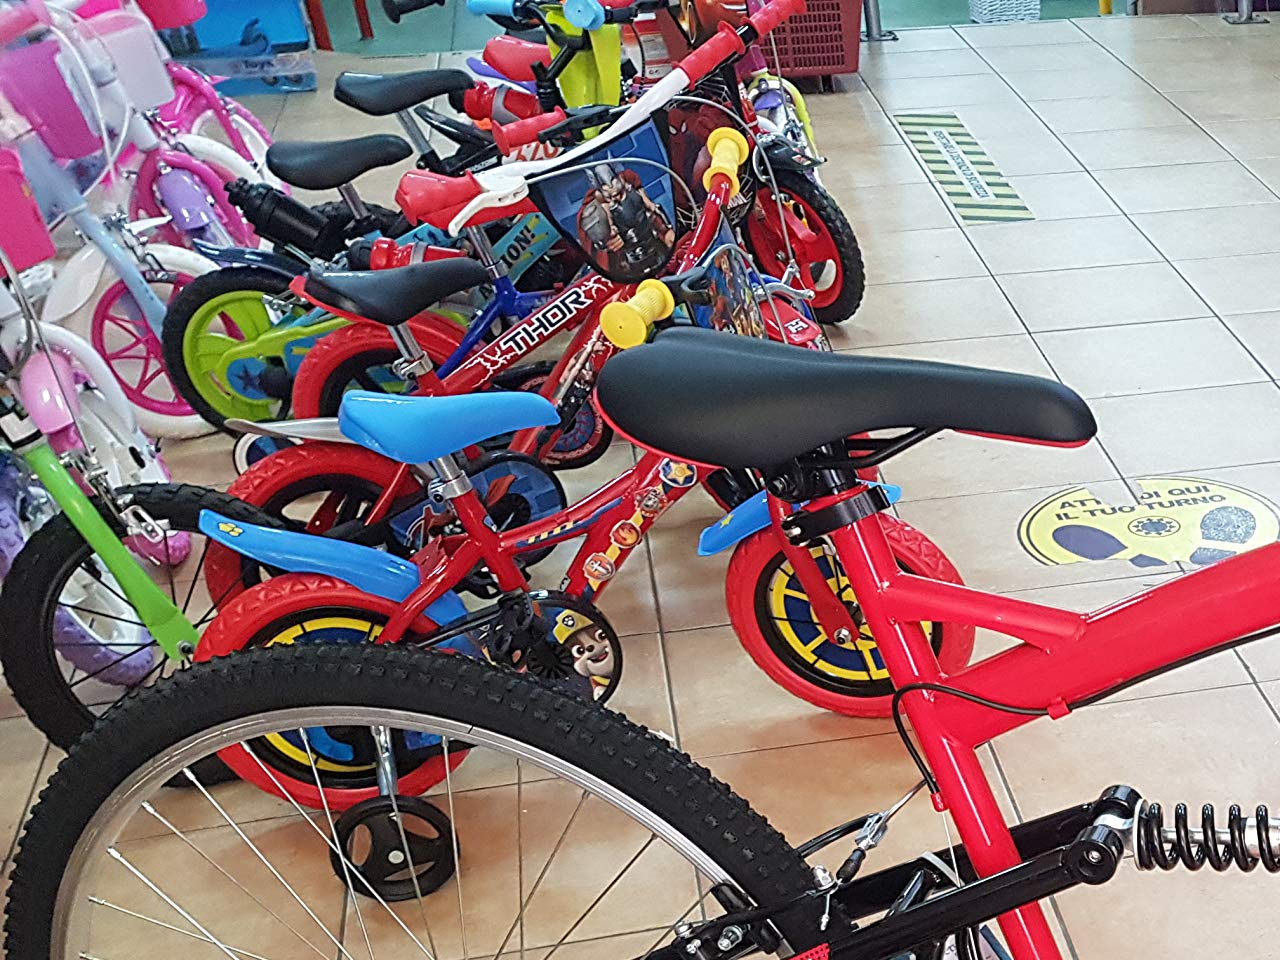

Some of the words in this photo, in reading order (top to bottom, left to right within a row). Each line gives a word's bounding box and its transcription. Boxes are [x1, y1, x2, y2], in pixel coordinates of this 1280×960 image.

[501, 286, 591, 355] THOR
[1168, 485, 1211, 496] QUI
[1056, 512, 1078, 521] IL
[1083, 504, 1137, 517] TUO
[1141, 494, 1227, 511] TURNO
